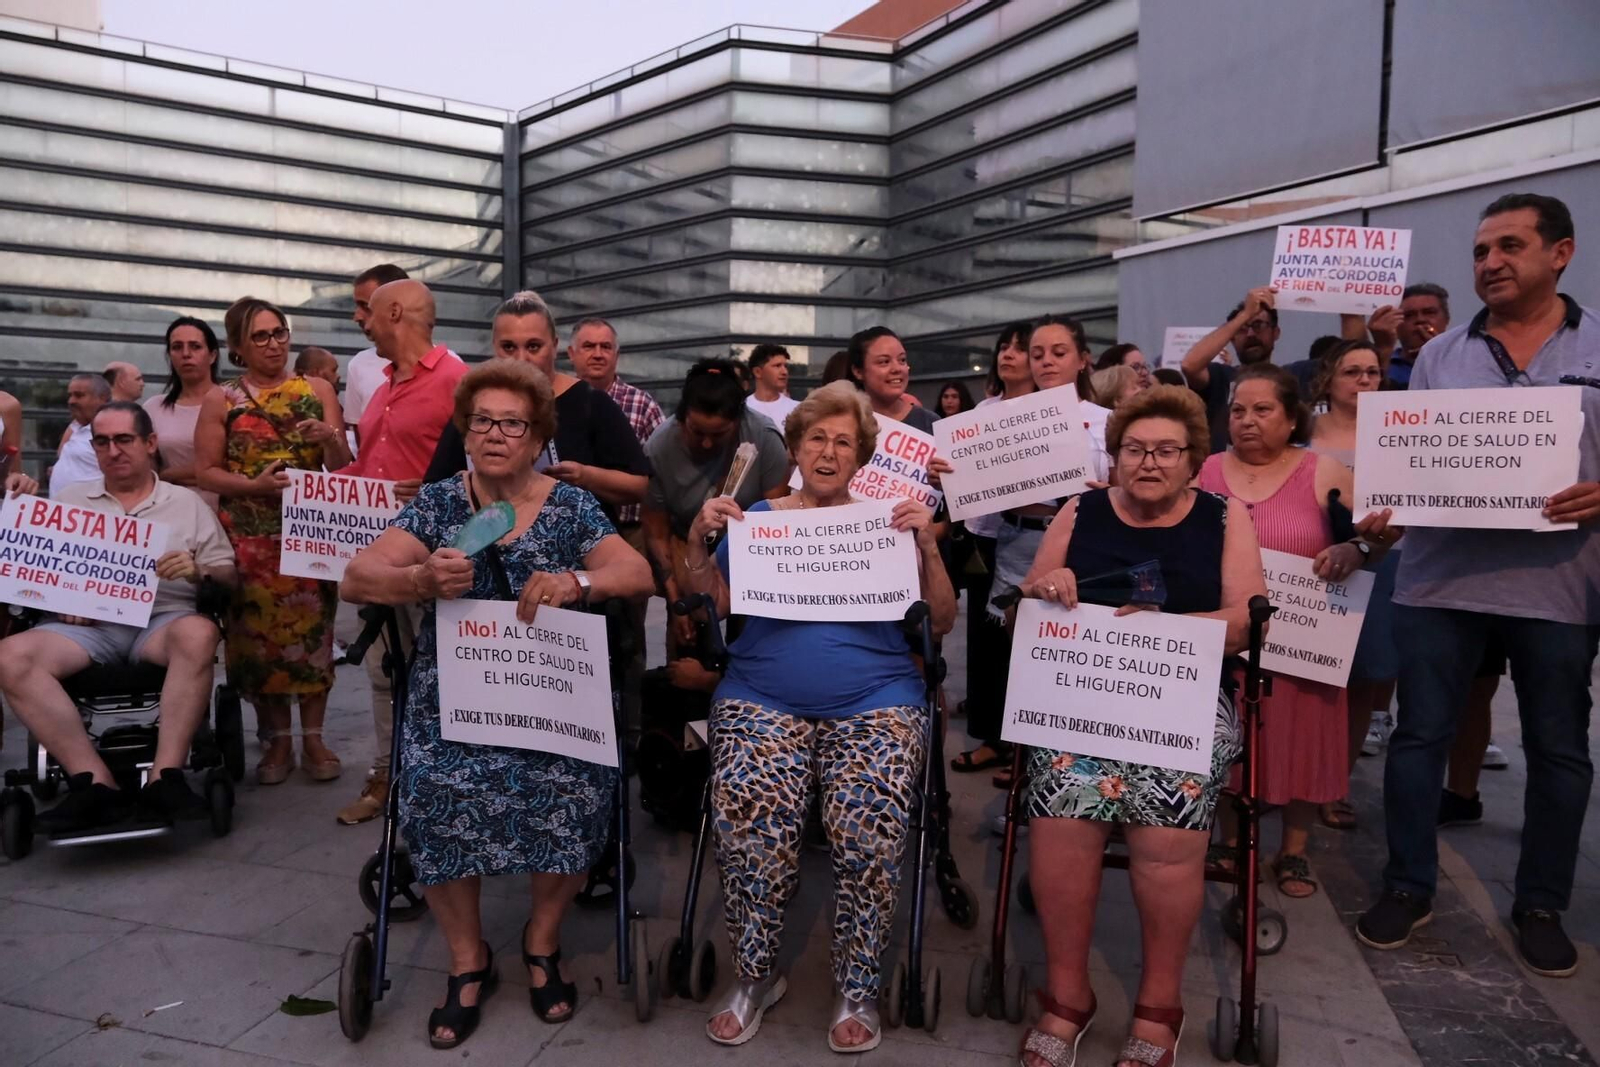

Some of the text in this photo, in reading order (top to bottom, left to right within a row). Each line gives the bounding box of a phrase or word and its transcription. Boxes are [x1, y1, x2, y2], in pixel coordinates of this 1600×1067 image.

[1297, 228, 1357, 248] BASTA
[1364, 229, 1385, 250] YA
[1275, 255, 1404, 269] JUNTA ANDALUCÍA
[1273, 279, 1289, 290] SE
[1292, 280, 1325, 292] RIEN
[1344, 282, 1403, 296] PUEBLO
[951, 405, 1062, 443] ¡No! AL CIERRE DEL
[1384, 409, 1554, 427] ¡No! AL CIERRE DEL
[951, 421, 1069, 460] CENTRO DE SALUD EN
[1378, 434, 1557, 448] CENTRO DE SALUD EN
[976, 443, 1050, 470] EL HIGUERON
[1410, 455, 1522, 469] EL HIGUERON
[304, 473, 360, 506] BASTA
[364, 481, 389, 509] YA
[849, 479, 902, 500] HIGUE
[867, 471, 888, 487] DE
[889, 479, 938, 508] SALUD
[958, 490, 981, 505] EXIGE
[981, 487, 996, 500] TUS
[996, 478, 1036, 497] DERECHOS
[1036, 467, 1082, 487] SANITARIOS
[1371, 493, 1406, 507] EXIGE
[1406, 494, 1427, 507] TUS
[1428, 494, 1487, 509] DERECHOS
[1489, 495, 1549, 509] SANITARIO
[30, 500, 106, 539] BASTA
[114, 517, 138, 546] YA
[284, 505, 394, 531] JUNTA ANDALU
[751, 516, 890, 540] ¡No! AL CIERRE DEL
[289, 523, 382, 546] AYUNT.CÓRD
[748, 536, 896, 556] CENTRO DE SALUD EN
[0, 528, 157, 572] JUNTA ANDALUCÍA
[285, 538, 301, 552] SE
[305, 541, 337, 556] RIEN
[340, 551, 352, 559] DEL
[0, 546, 147, 587] AYUNT.CÓRDOBA
[777, 559, 870, 573] EL HIGUERON
[0, 563, 154, 604] E RIEN DEL PUEBLO
[1279, 572, 1321, 591] CIERRE
[1325, 583, 1348, 598] DEL
[747, 589, 776, 603] EXIGE
[777, 593, 796, 605] TUS
[796, 594, 848, 606] DERECHOS
[849, 590, 905, 605] SANITARIOS
[1267, 589, 1348, 617] DE SALUD EN
[1273, 610, 1318, 628] UERON
[458, 620, 589, 652] ¡No! AL CIERRE DEL
[1038, 621, 1196, 656] ¡No! AL CIERRE DEL
[1261, 641, 1286, 656] CHOS
[455, 646, 594, 677] CENTRO DE SALUD EN
[1031, 647, 1198, 682] CENTRO DE SALUD EN
[484, 671, 573, 694] EL HIGUERON
[1056, 672, 1162, 700] EL HIGUERON
[454, 708, 483, 725] EXIGE
[483, 712, 503, 726] TUS
[504, 713, 553, 732] DERECHOS
[554, 720, 601, 744] SANITARIOS
[1018, 709, 1046, 727] EXIGE
[1049, 714, 1067, 730] TUS
[1068, 717, 1126, 739] DERECHOS
[1128, 726, 1193, 750] SANITARIOS
